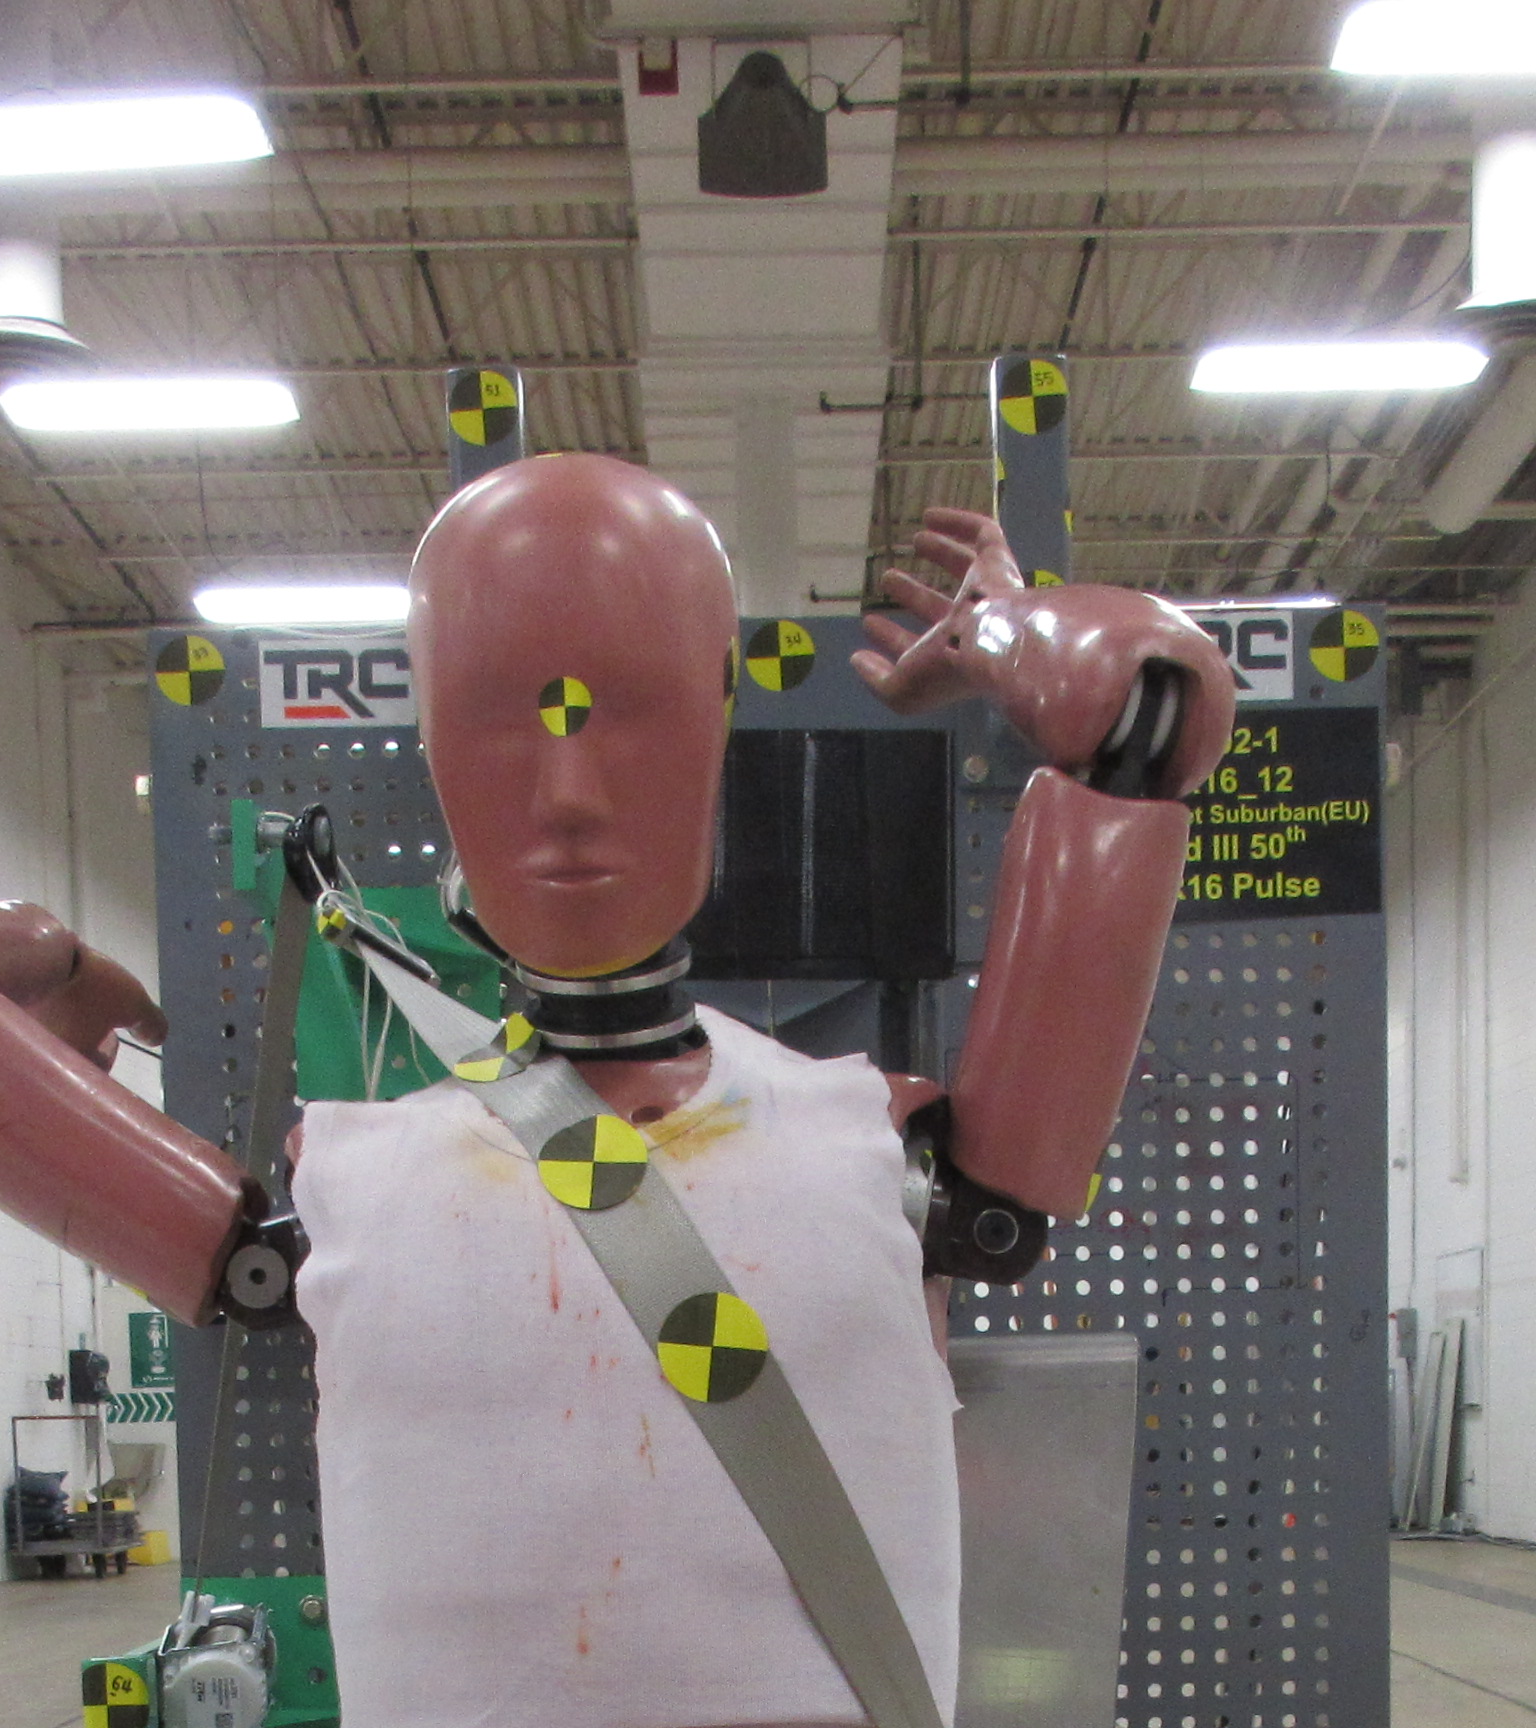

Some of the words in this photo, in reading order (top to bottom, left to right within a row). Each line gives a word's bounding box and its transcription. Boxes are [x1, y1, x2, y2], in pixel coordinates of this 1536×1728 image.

[1196, 619, 1289, 690] RC
[264, 649, 410, 719] TRC
[1224, 727, 1279, 754] 2-1
[1210, 800, 1370, 825] Suburban(EU)
[1213, 834, 1239, 860] III
[1233, 872, 1321, 900] Pulse
